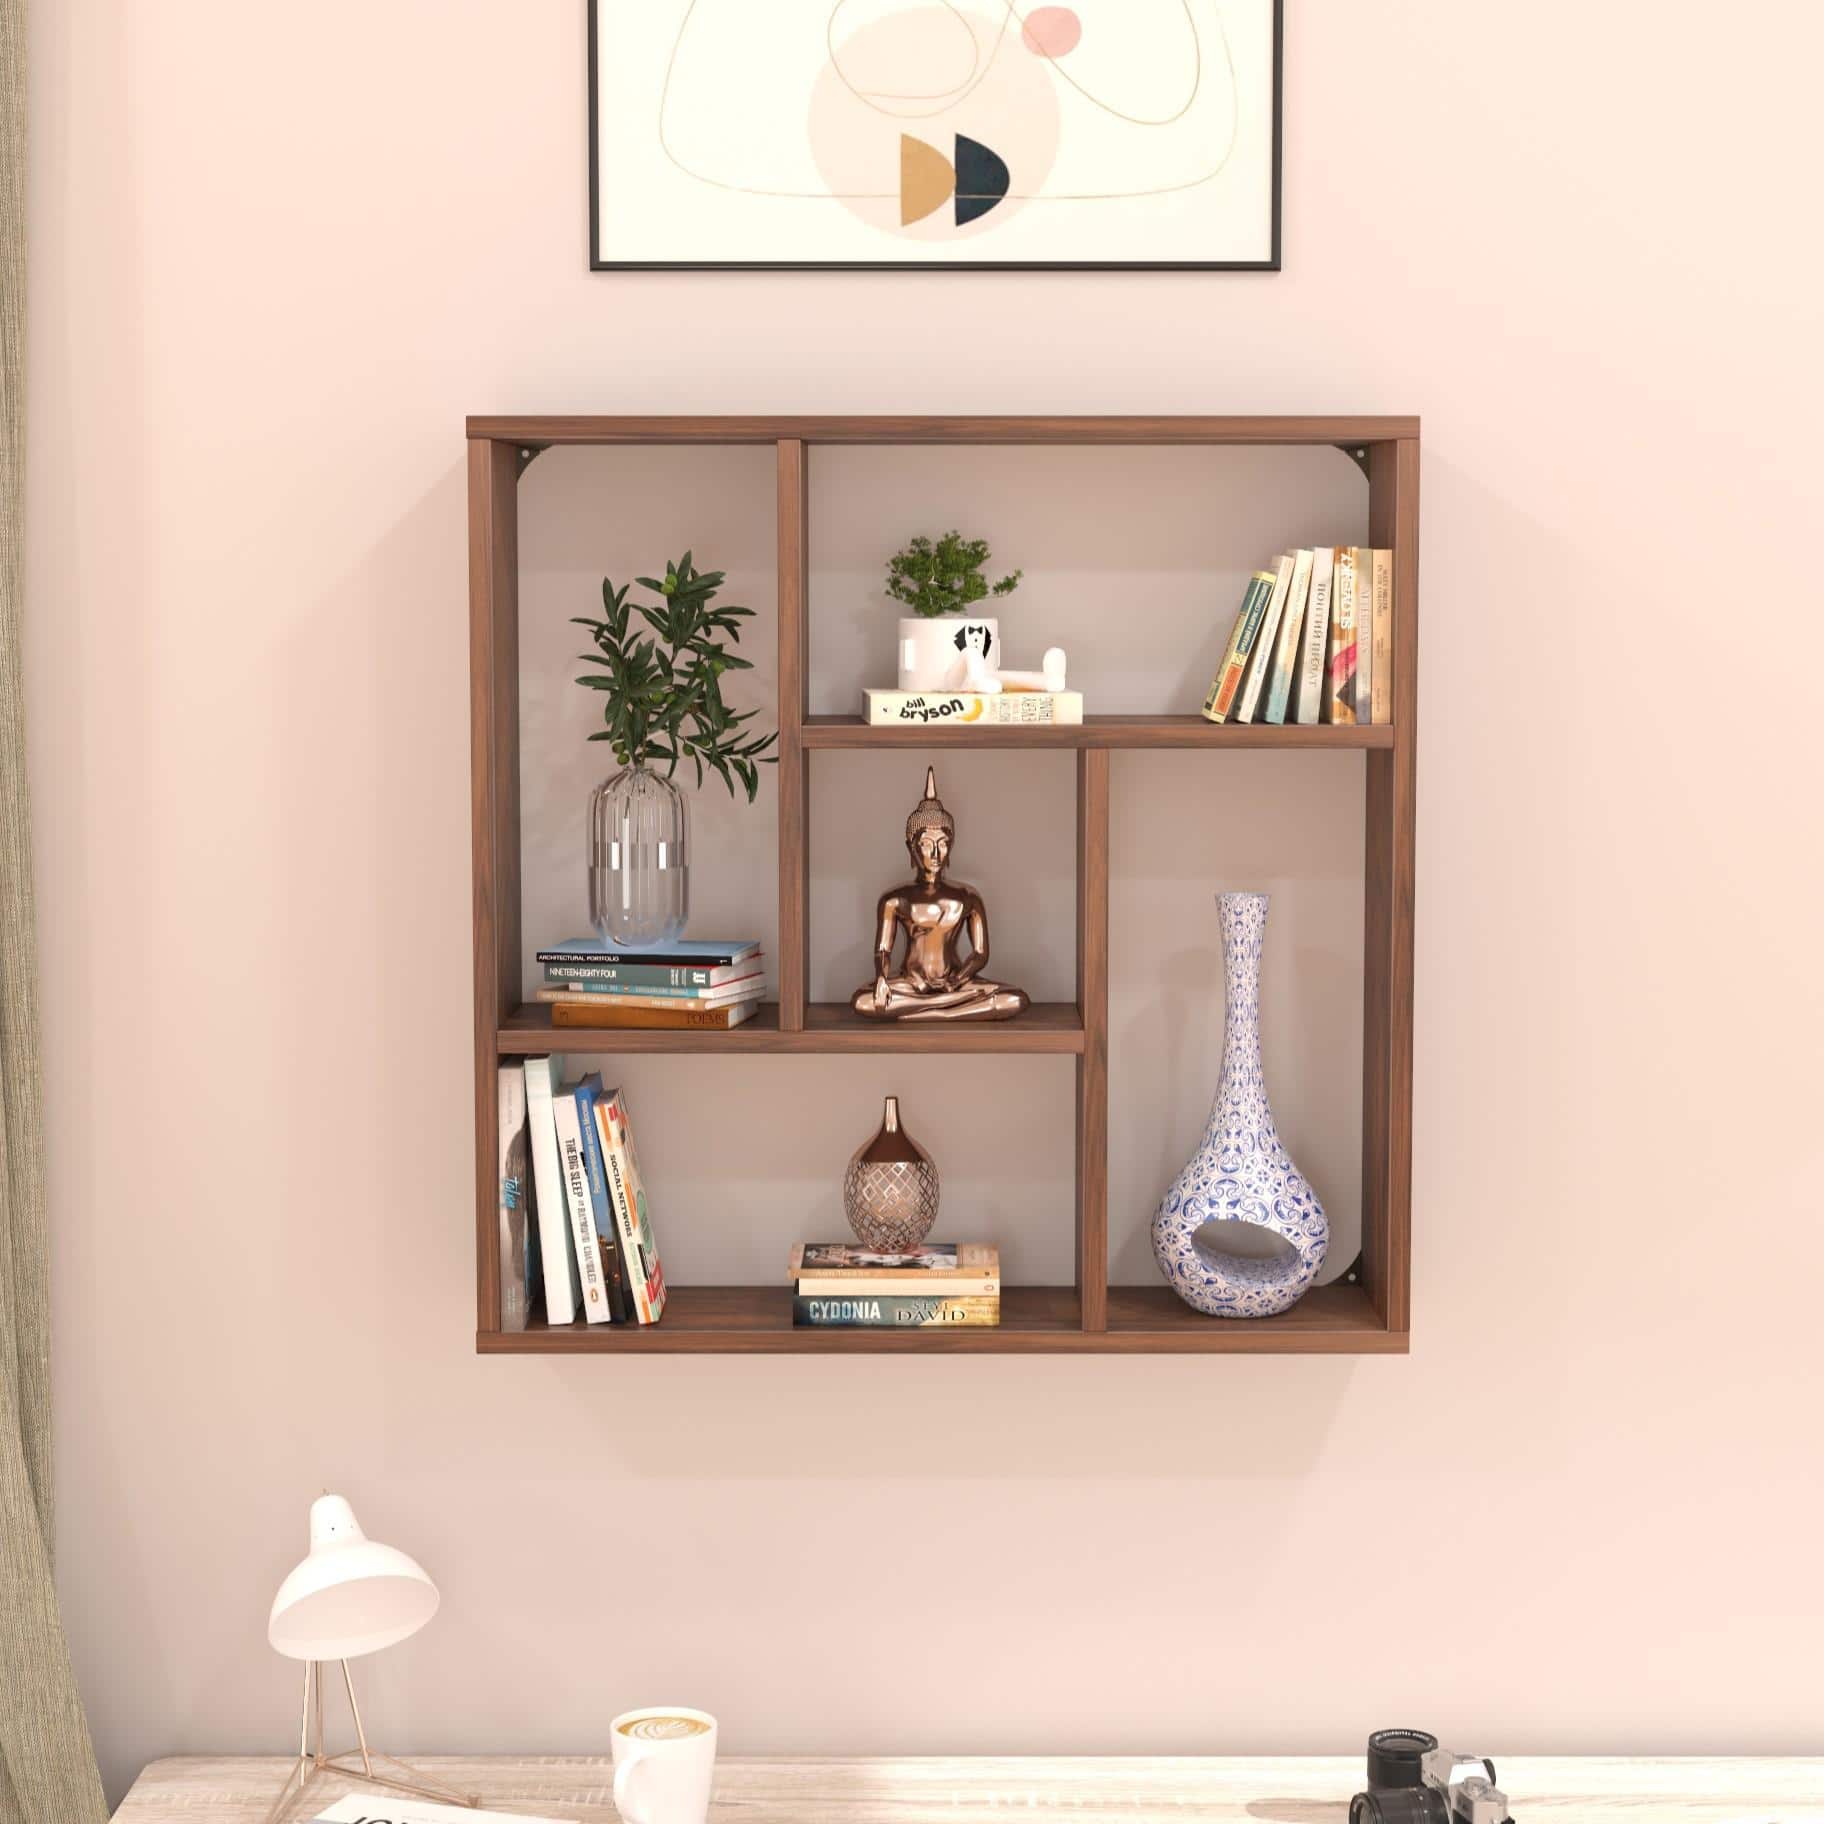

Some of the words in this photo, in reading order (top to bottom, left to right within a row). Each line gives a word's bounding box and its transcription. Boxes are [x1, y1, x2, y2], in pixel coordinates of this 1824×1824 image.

[899, 699, 965, 723] bryson
[906, 697, 925, 709] bill
[538, 954, 585, 962] ARCHITECTURAL
[687, 1011, 725, 1025] POEMS
[565, 1138, 576, 1155] THE
[609, 1154, 622, 1190] SOCIAL
[570, 1171, 583, 1198] SLEEP
[809, 1301, 881, 1320] CYDONIA
[897, 1309, 966, 1321] DAVID
